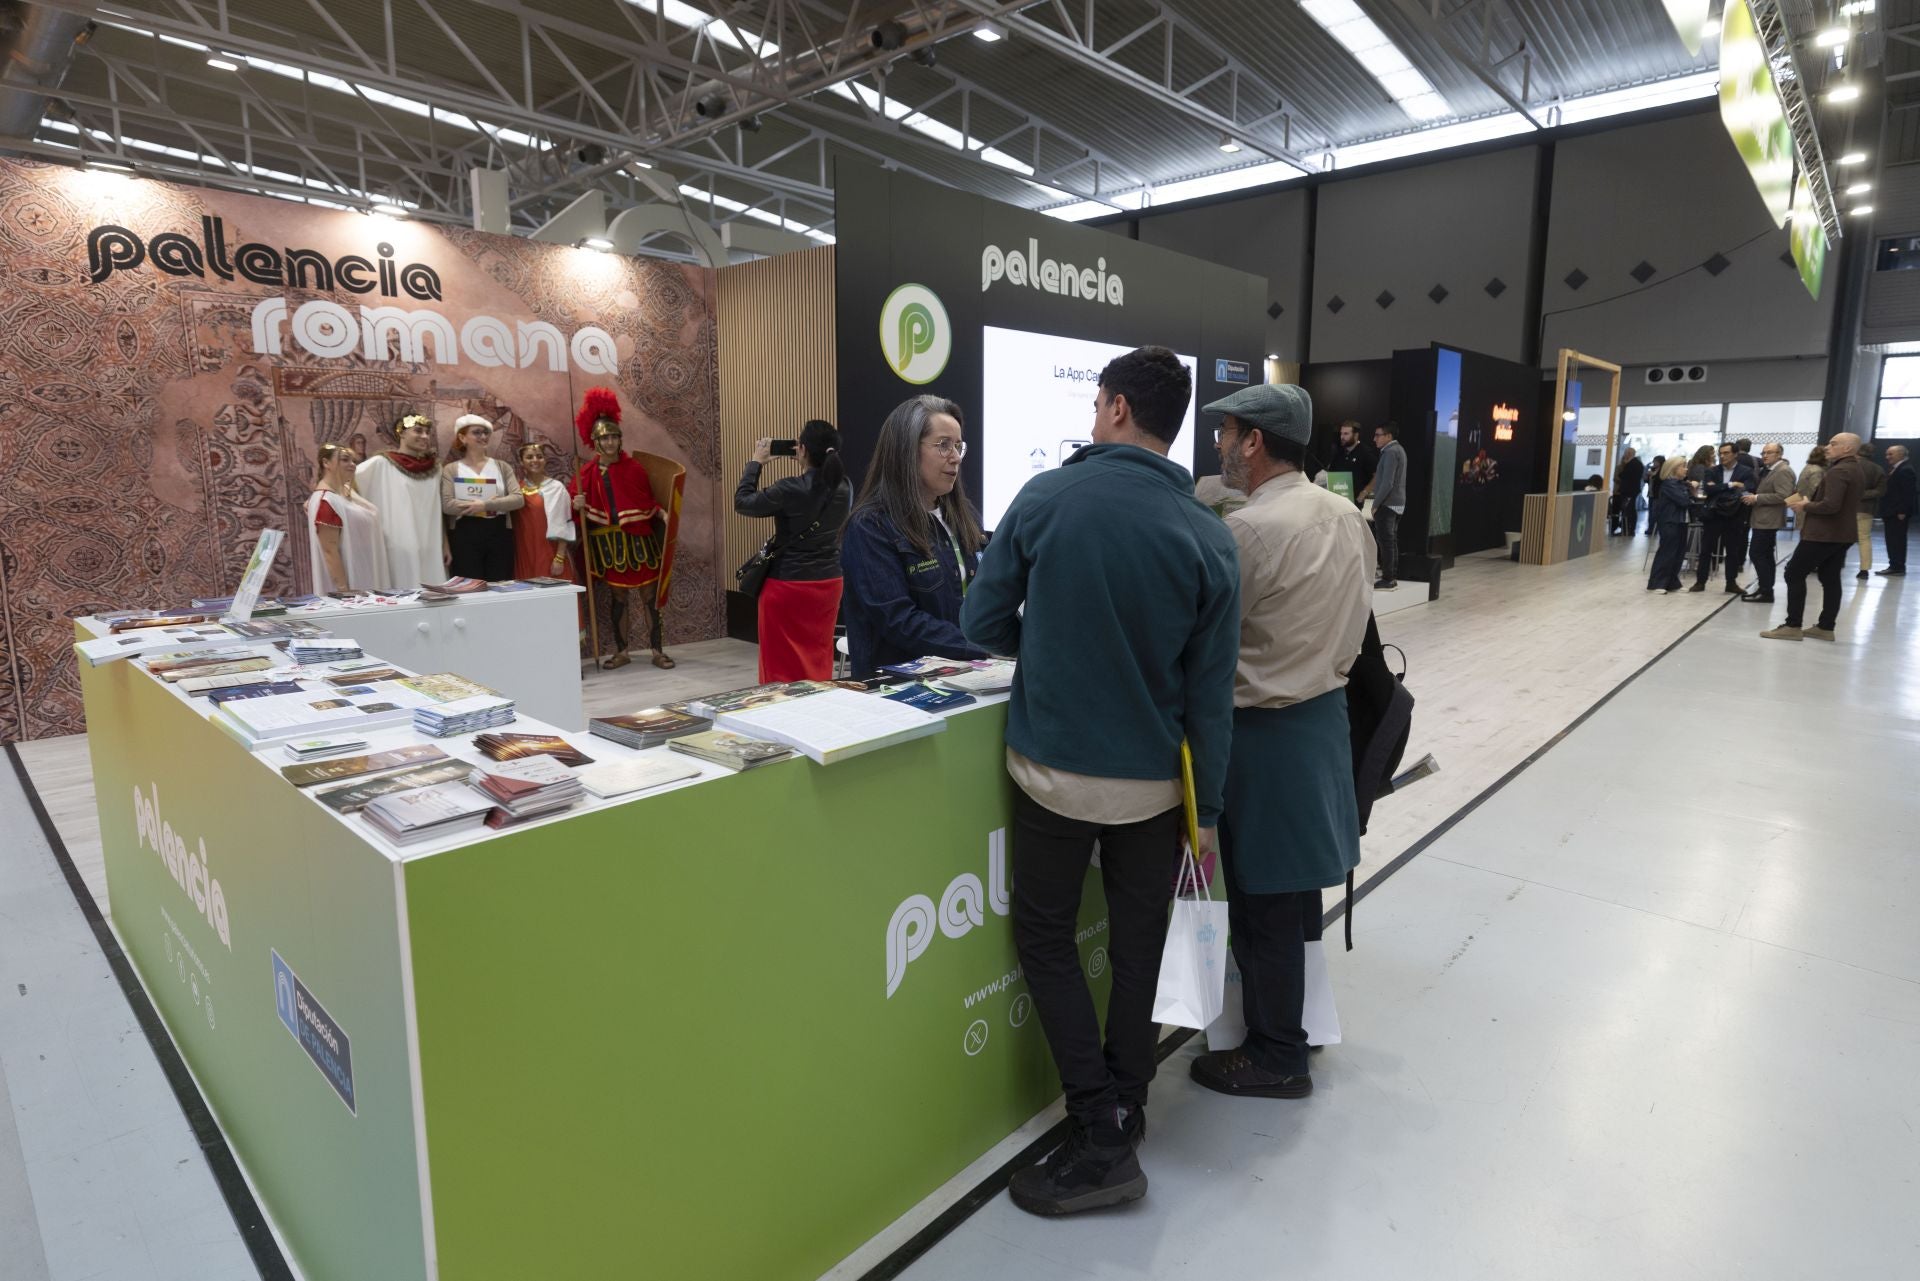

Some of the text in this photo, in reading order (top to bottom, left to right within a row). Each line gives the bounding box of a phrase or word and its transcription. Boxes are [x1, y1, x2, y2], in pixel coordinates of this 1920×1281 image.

[88, 216, 442, 301] palencia
[982, 237, 1124, 306] palencia
[252, 297, 618, 376] romana
[1054, 365, 1065, 378] La
[1067, 367, 1084, 382] App
[134, 781, 232, 953] palencia
[296, 990, 339, 1055] Diputación
[299, 1021, 352, 1098] DE PALENCIA
